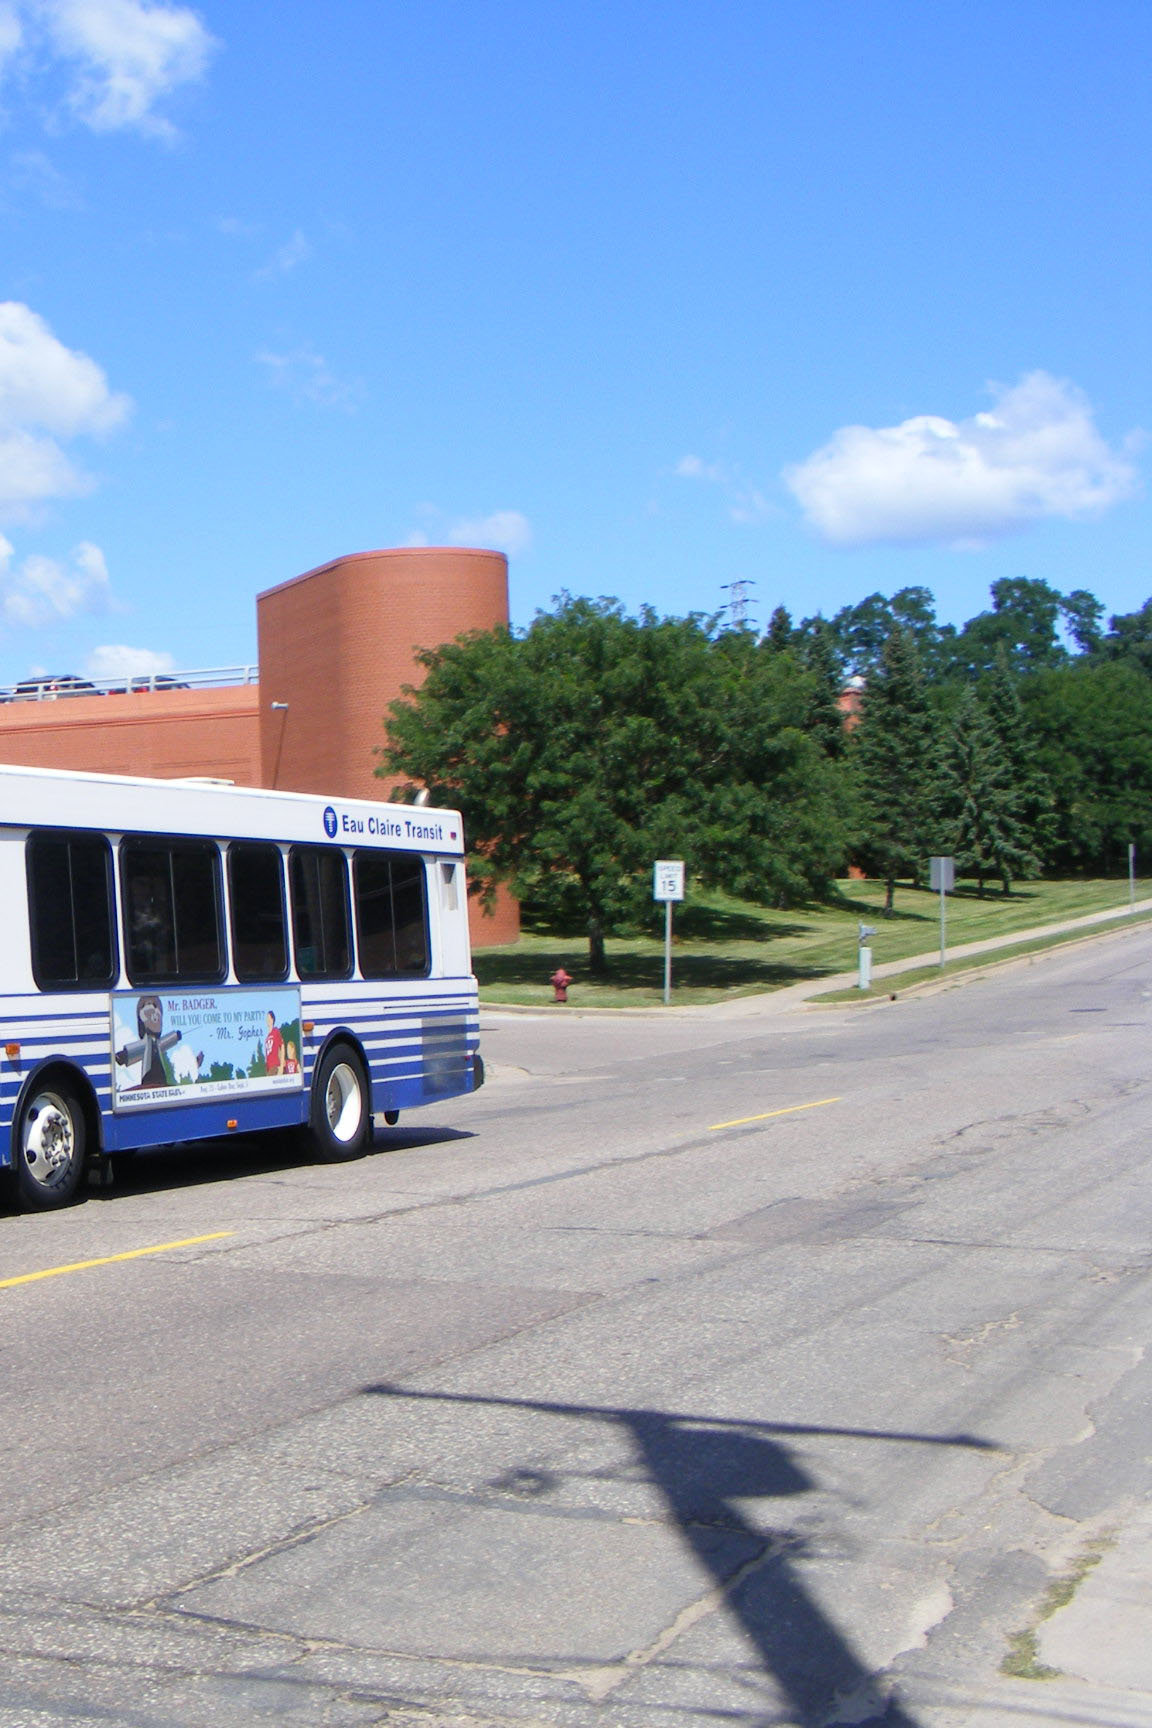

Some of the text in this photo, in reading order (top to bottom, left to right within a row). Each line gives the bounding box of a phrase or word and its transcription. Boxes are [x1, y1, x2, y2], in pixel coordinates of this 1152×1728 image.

[342, 814, 443, 841] Eau Claire Transit
[662, 880, 676, 892] 15
[167, 1000, 181, 1012] Mr.
[170, 1015, 187, 1026] WILL
[188, 1014, 201, 1025] YOU
[202, 1013, 221, 1024] COME
[223, 1012, 232, 1023] TO
[233, 1011, 242, 1022] MY
[238, 1025, 264, 1041] Gopher
[119, 1092, 151, 1103] MINNESOTA
[152, 1090, 167, 1099] STATE
